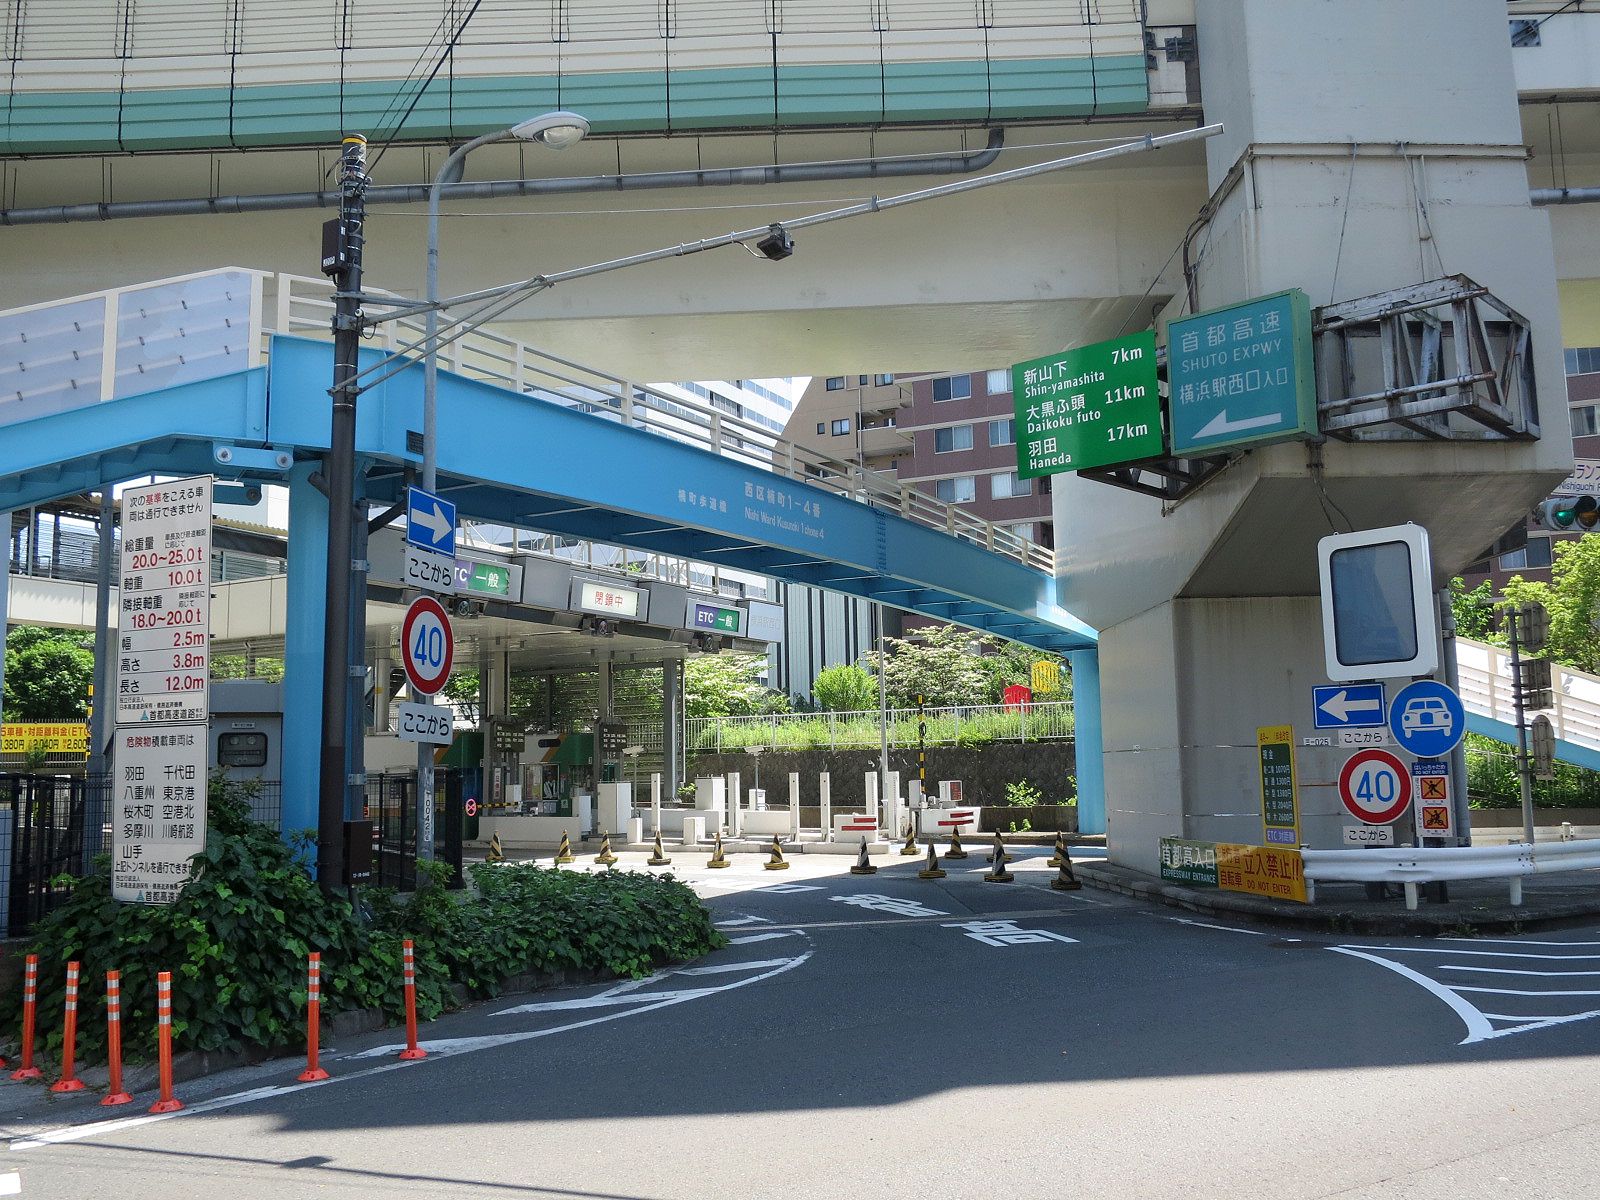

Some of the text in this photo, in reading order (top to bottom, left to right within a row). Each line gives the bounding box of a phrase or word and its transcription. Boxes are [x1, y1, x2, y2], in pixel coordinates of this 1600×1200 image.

[1181, 311, 1281, 353] 首都高速
[1111, 346, 1143, 365] 7km
[1182, 339, 1281, 374] SHUTO EXPWY
[1023, 360, 1068, 385] 新山下
[1025, 369, 1105, 398] Shin-yamashita
[1179, 367, 1288, 405] 横浜駅西口入口
[1105, 384, 1145, 405] 11km
[1026, 394, 1085, 421] 大黒ふ頭
[1027, 409, 1101, 434] Daikoku futo
[1107, 423, 1148, 442] 17km
[1028, 438, 1057, 457] 羽田
[1029, 452, 1071, 470] Haneda
[129, 486, 204, 508] 次の基準をこえる車
[129, 502, 204, 522] 両は通行できません
[760, 511, 776, 527] Ward
[125, 536, 154, 552] 総重量
[409, 558, 452, 586] ここから
[476, 572, 499, 588] 一般
[124, 576, 143, 590] 軸重
[122, 595, 163, 612] 隣接軸重
[595, 591, 623, 607] 閉鎖中
[698, 611, 732, 628] ETC 一般
[122, 637, 131, 651] 幅
[173, 631, 205, 647] 2.5m
[414, 624, 442, 667] 40
[120, 658, 141, 672] 高さ
[173, 653, 204, 669] 3.8m
[119, 680, 140, 694] 長さ
[165, 675, 204, 691] 12.0m
[149, 709, 195, 720] 首都高速道路
[404, 712, 449, 736] ここから
[127, 734, 195, 748] 危険物積載車両は
[1344, 732, 1382, 743] ここから
[125, 765, 195, 781] 羽田 千代田
[124, 785, 194, 801] 八重州 東京港
[1356, 770, 1394, 802] 40
[123, 804, 194, 819] 桜木町 空港北
[123, 823, 194, 839] 多摩川 川崎航路
[1349, 830, 1388, 840] ここから
[123, 844, 142, 859] 山手
[1162, 844, 1216, 871] 首都高入口
[1163, 869, 1216, 884] EXPRESSWAY ENTRANCE
[1220, 870, 1242, 887] 自転車
[1247, 880, 1291, 895] DO NOT ENTER
